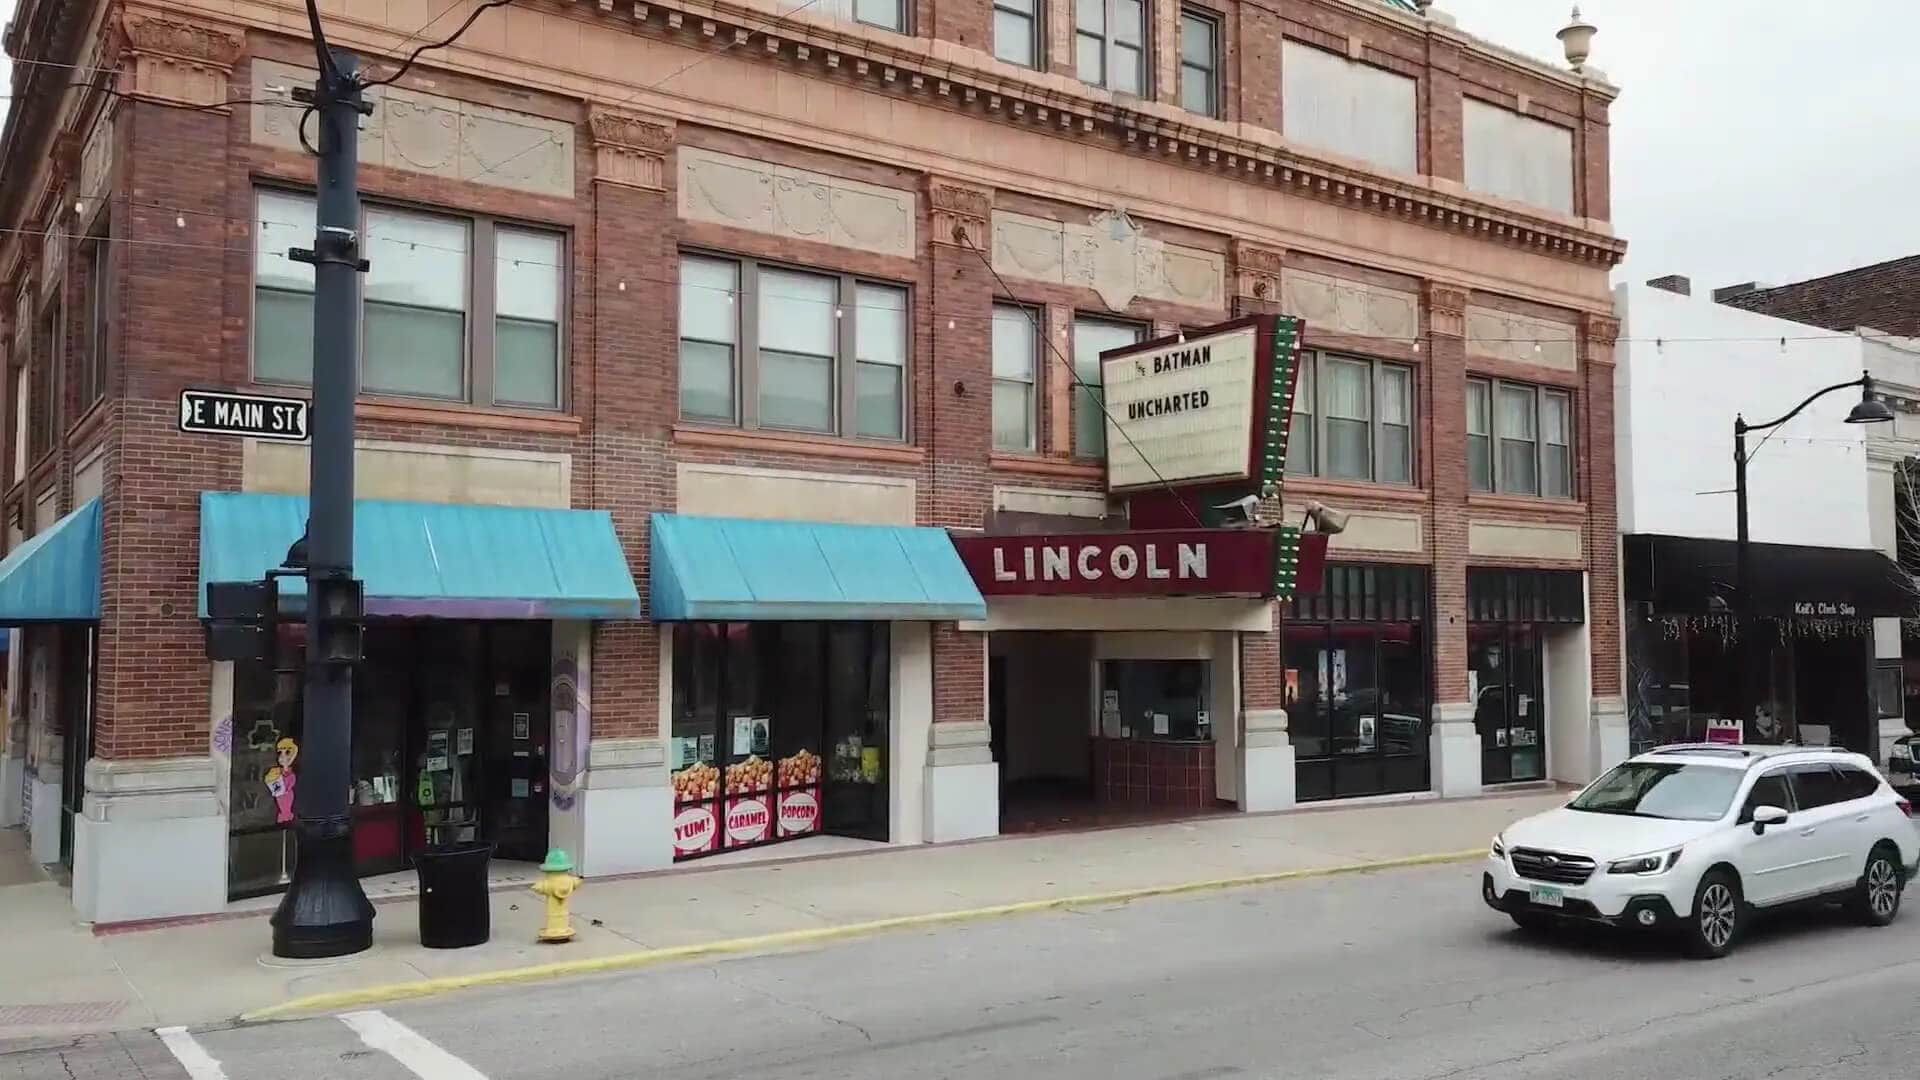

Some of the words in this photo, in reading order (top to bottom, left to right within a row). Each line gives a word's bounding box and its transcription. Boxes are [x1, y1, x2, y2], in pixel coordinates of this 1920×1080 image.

[1154, 345, 1211, 374] BATMAN
[194, 400, 205, 424] E
[215, 401, 263, 428] MAIN
[272, 406, 295, 430] ST
[1128, 390, 1209, 419] UNCHARTED
[993, 543, 1208, 581] LINCOLN
[728, 811, 766, 830] CARAMEL
[781, 805, 816, 819] POPCORN
[674, 817, 710, 841] YUM!
